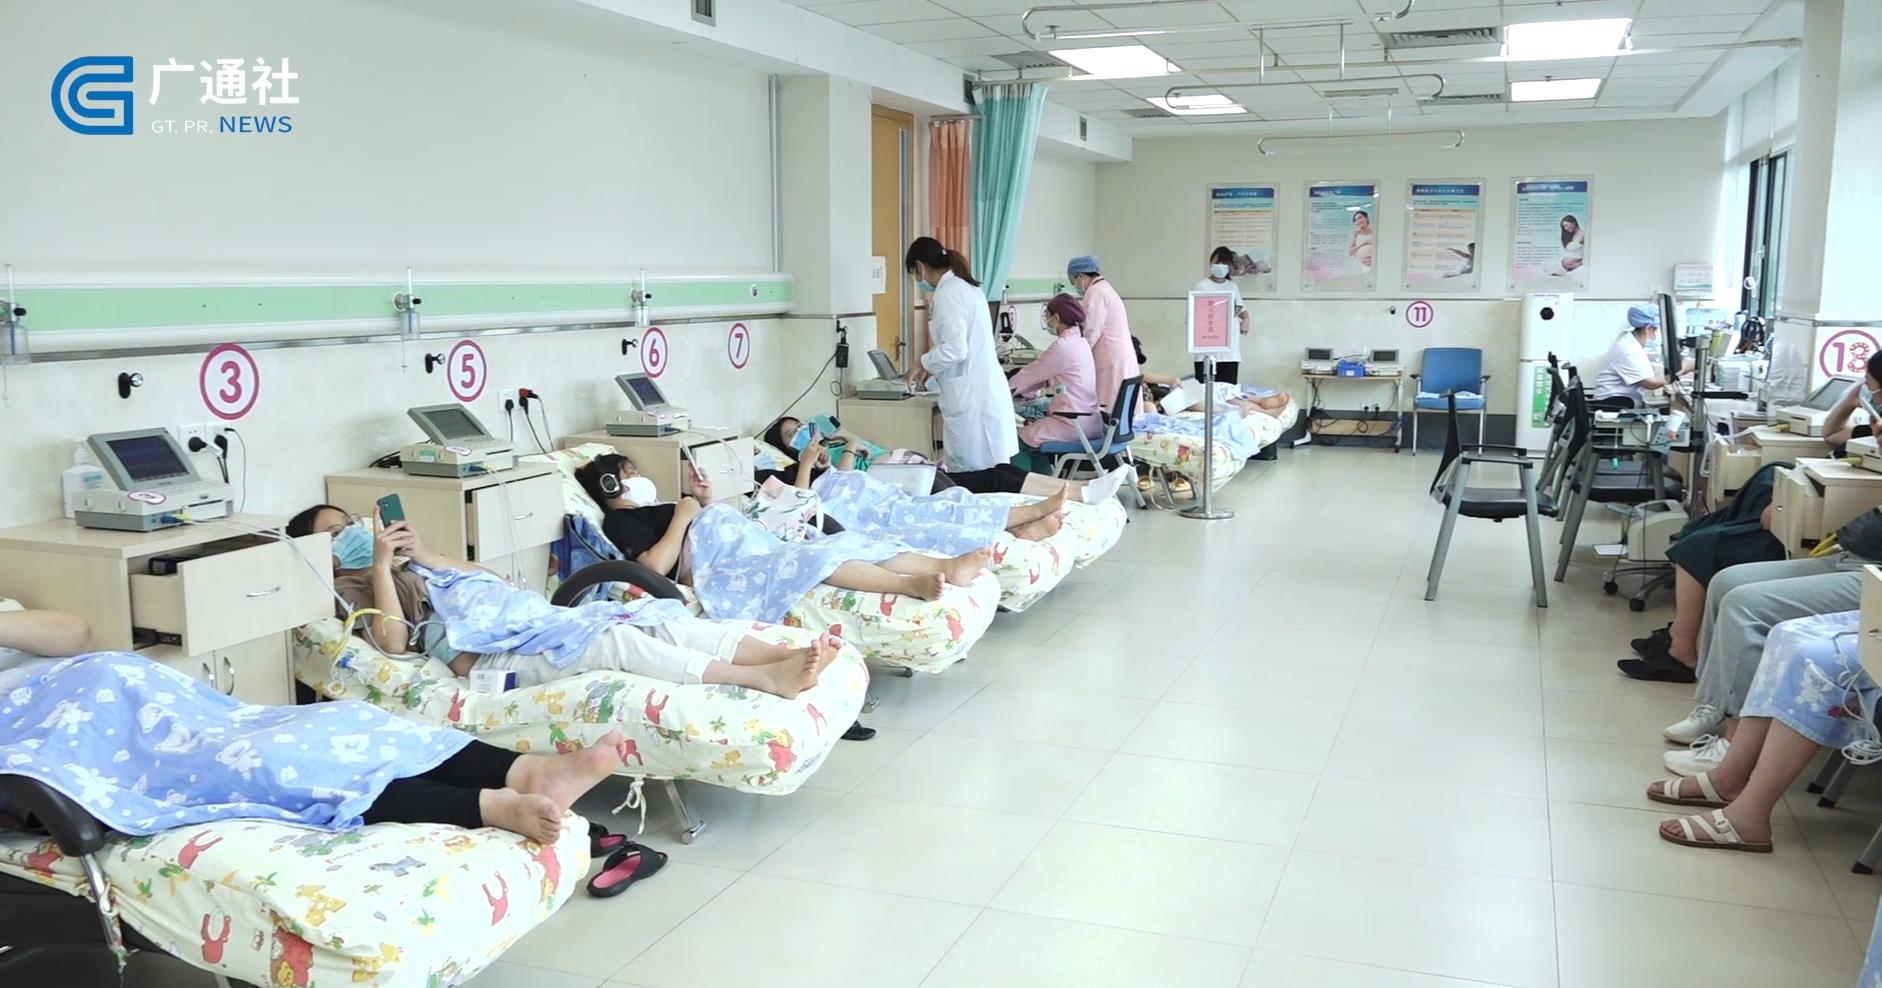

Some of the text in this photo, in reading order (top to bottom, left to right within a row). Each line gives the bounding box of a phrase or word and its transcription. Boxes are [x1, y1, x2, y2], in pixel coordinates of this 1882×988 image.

[1414, 306, 1427, 322] 11
[649, 338, 660, 367] 6
[734, 332, 744, 359] 7
[219, 360, 242, 404] 3
[460, 353, 476, 389] 5
